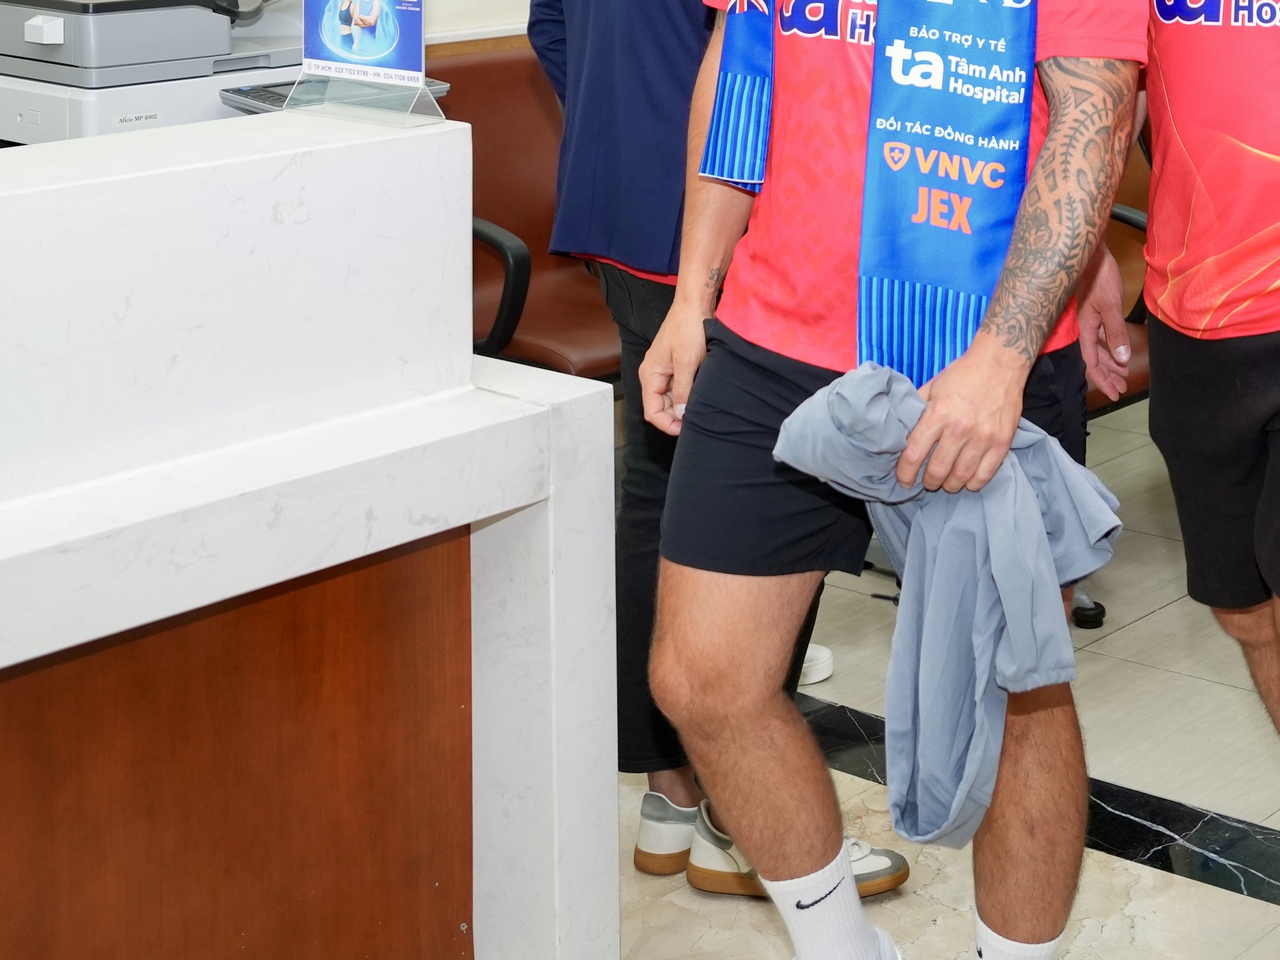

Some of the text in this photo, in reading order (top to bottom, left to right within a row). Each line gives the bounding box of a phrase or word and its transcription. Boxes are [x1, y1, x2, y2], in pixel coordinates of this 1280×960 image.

[909, 25, 1007, 53] BẢO TRỢ Y TẾ
[885, 39, 945, 91] ta
[947, 55, 1027, 84] Tâm Anh
[949, 77, 1026, 105] Hospital
[875, 115, 1020, 151] ĐỐI TÁC ĐỒNG HÀNH
[915, 146, 1006, 189] VNVC
[911, 186, 973, 235] JEX
